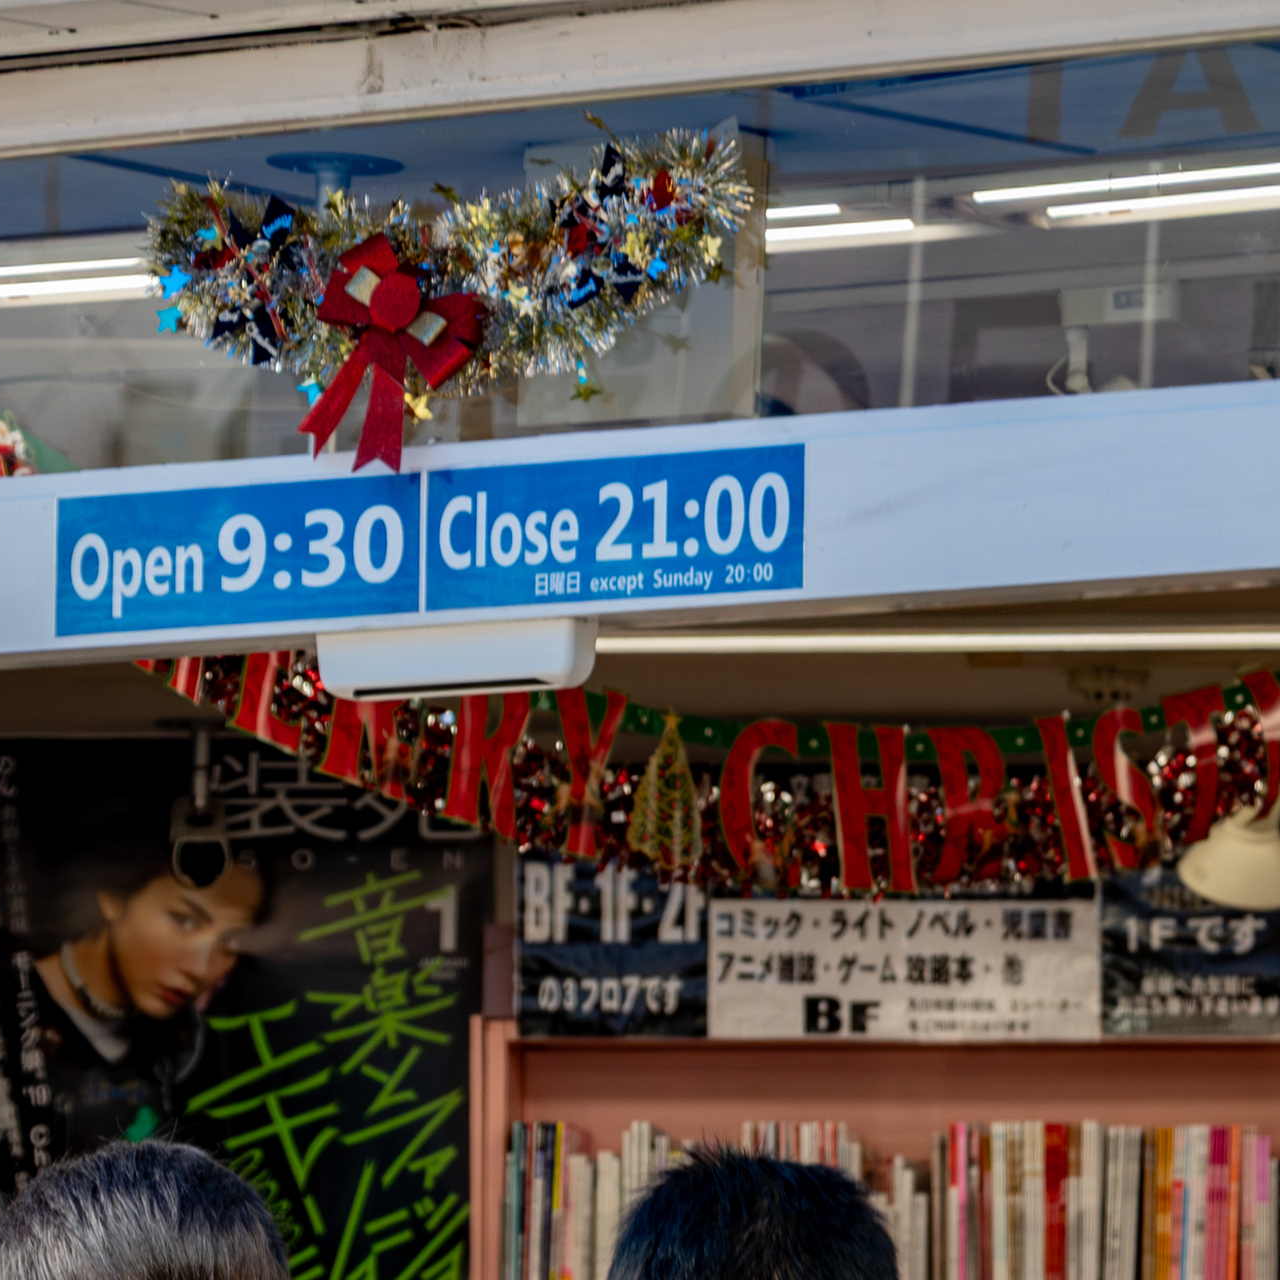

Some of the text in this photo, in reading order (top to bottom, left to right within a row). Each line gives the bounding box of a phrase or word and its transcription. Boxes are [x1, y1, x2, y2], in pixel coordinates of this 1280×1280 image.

[439, 470, 790, 569] Close 21:00
[72, 503, 404, 617] Open 9:30
[534, 562, 774, 597] 日曜日 except Sunday 20:00
[804, 996, 881, 1034] BF
